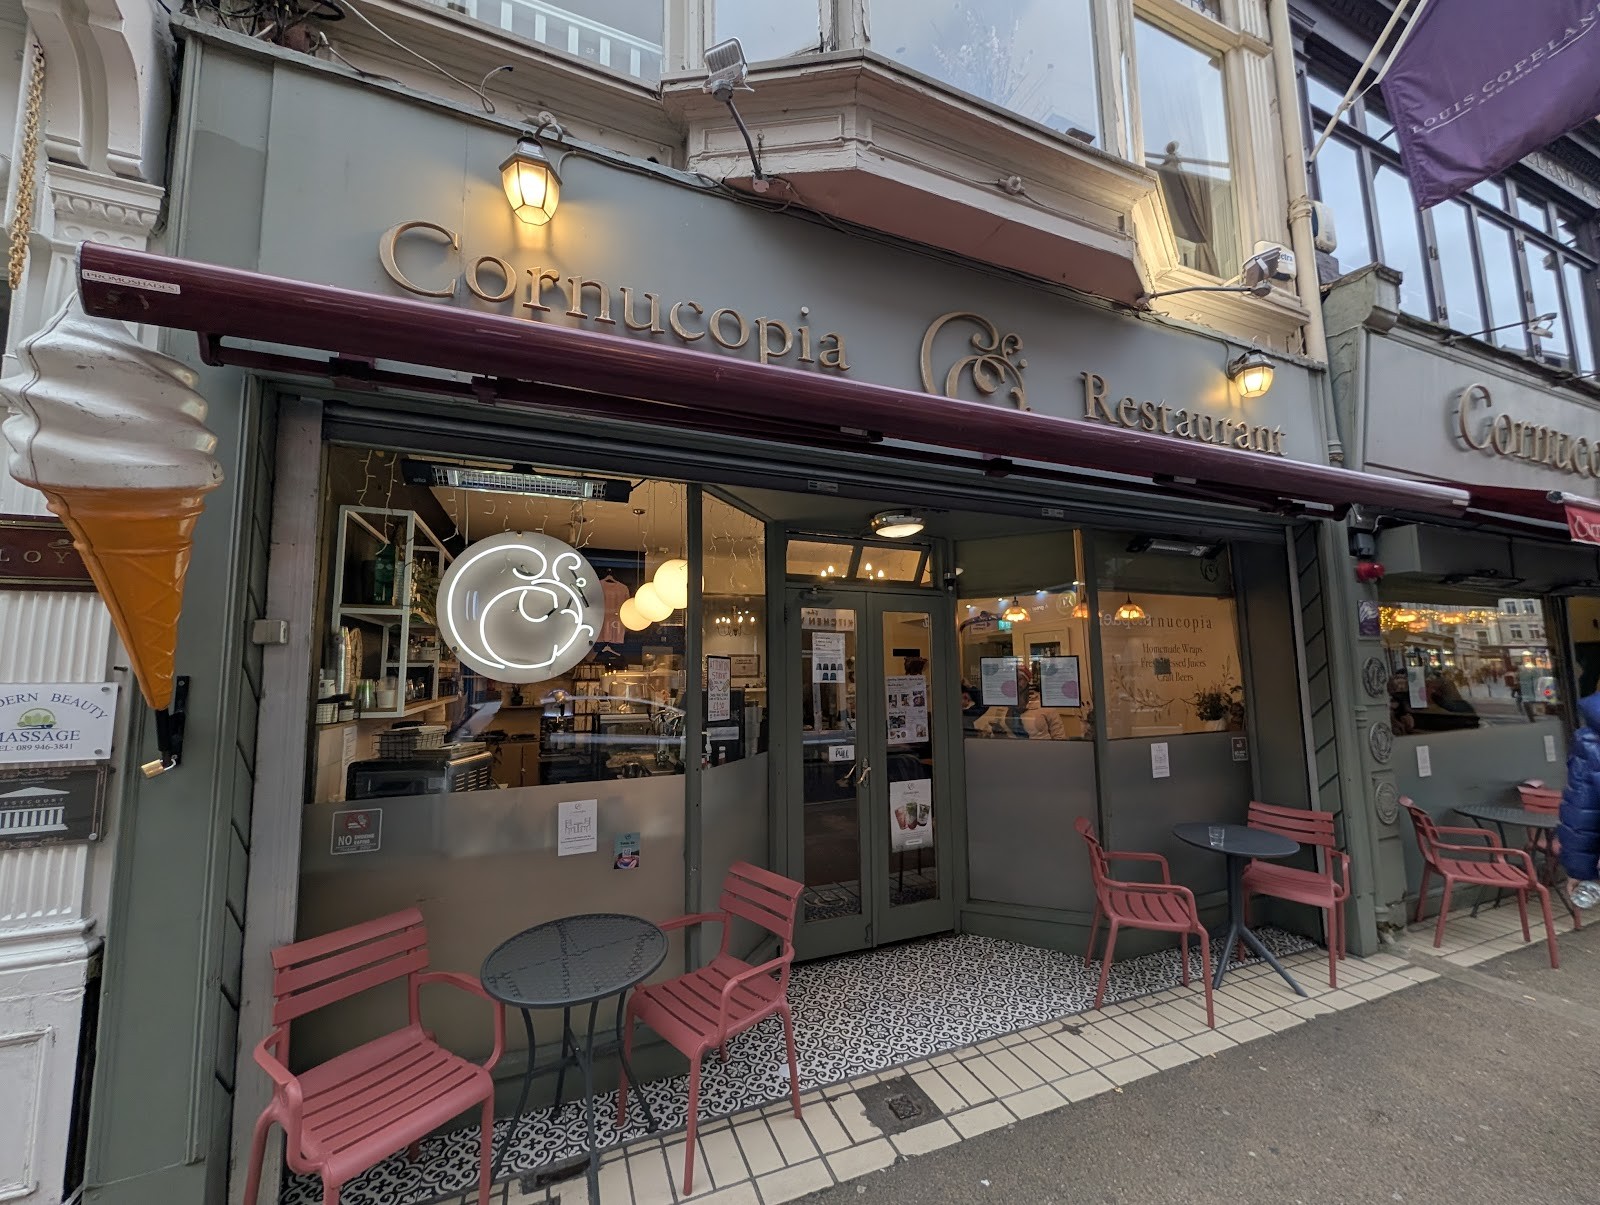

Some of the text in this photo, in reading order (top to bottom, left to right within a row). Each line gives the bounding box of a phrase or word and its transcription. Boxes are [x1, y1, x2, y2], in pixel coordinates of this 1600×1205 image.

[1410, 2, 1600, 134] LOUIS COPELAN
[379, 220, 851, 371] Cornucopia
[1080, 369, 1288, 457] Restaurant
[1142, 642, 1203, 656] Homemade Wraps
[51, 692, 109, 721] BEAUTY
[16, 743, 32, 751] 089
[34, 742, 74, 751] 946-3841
[337, 834, 353, 846] NO
